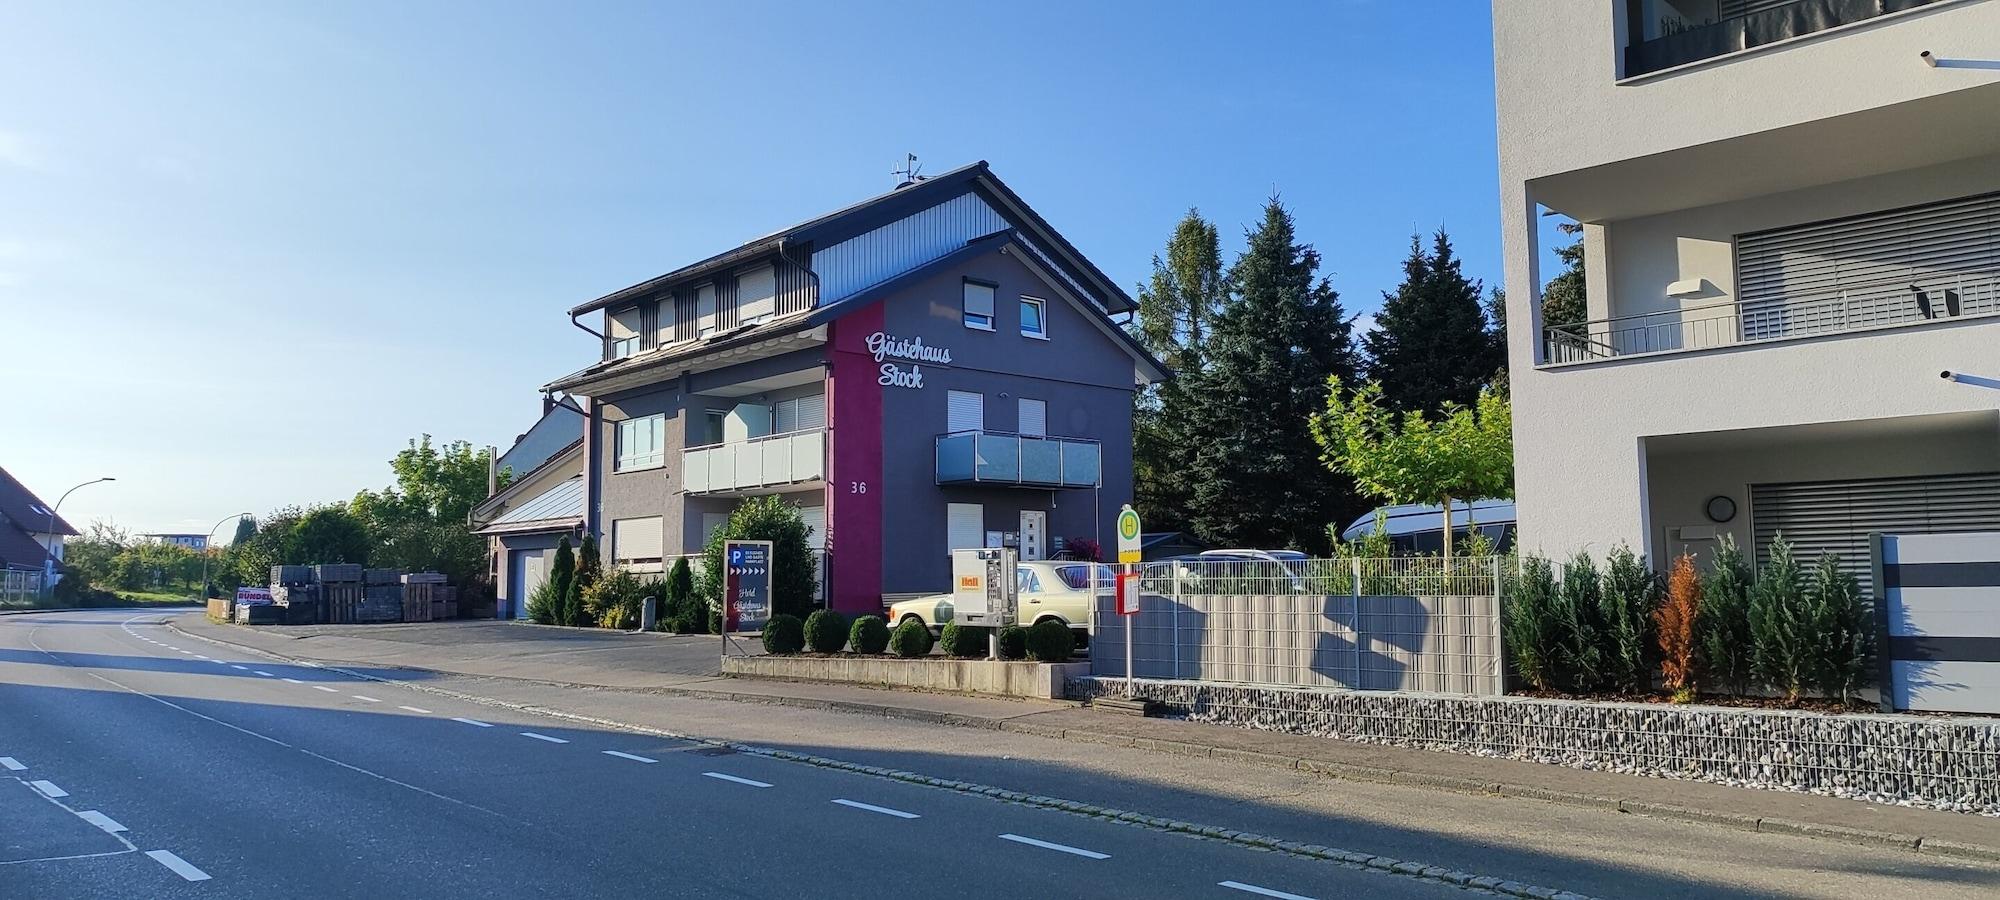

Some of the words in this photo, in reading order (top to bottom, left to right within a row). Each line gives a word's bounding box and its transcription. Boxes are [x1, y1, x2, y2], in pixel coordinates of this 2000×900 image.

[865, 332, 952, 363] Gästehaus
[878, 363, 924, 389] Stock
[851, 481, 866, 494] 36
[1125, 517, 1133, 534] H
[733, 550, 742, 564] P
